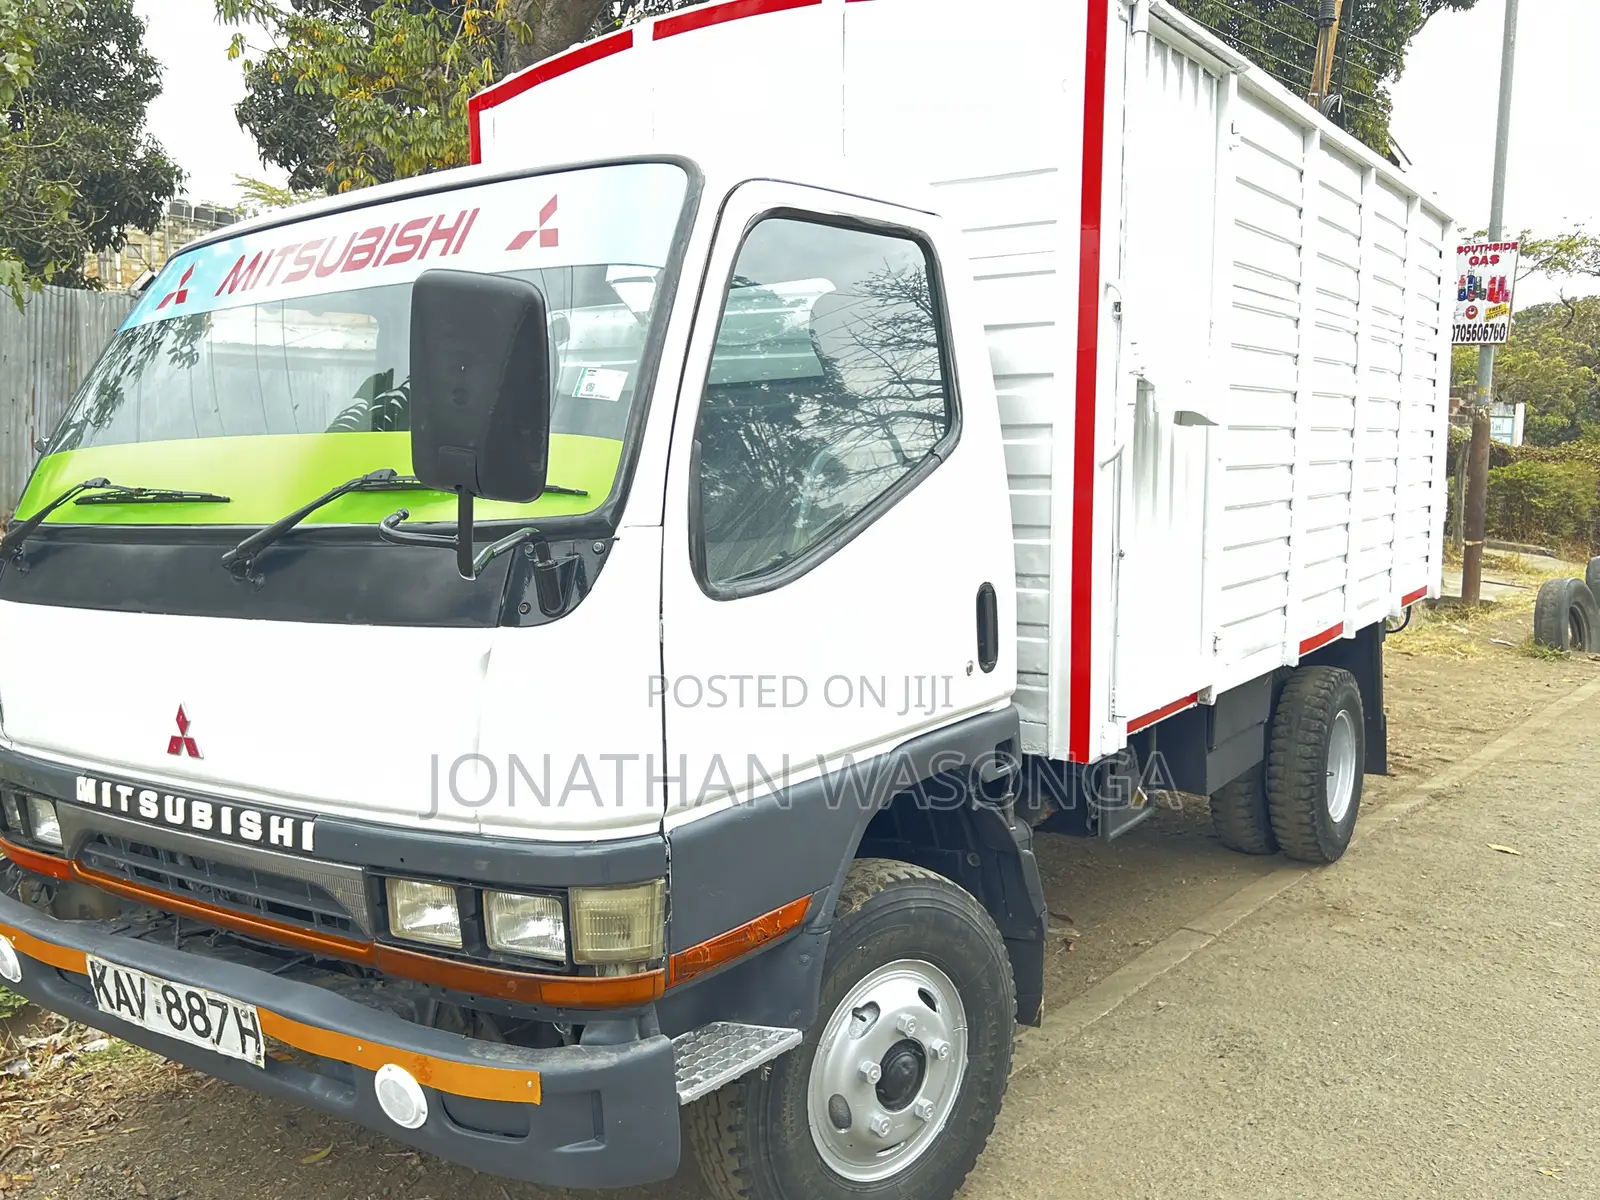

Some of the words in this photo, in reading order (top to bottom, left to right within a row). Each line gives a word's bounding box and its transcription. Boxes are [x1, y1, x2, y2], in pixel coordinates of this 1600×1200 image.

[214, 207, 480, 297] MITSUBISHI
[1456, 242, 1518, 255] SOUTHSIDE
[1468, 254, 1500, 267] GAS
[76, 776, 315, 852] MITSUBISHI
[89, 960, 146, 1022] KAV
[161, 984, 261, 1060] 887H
